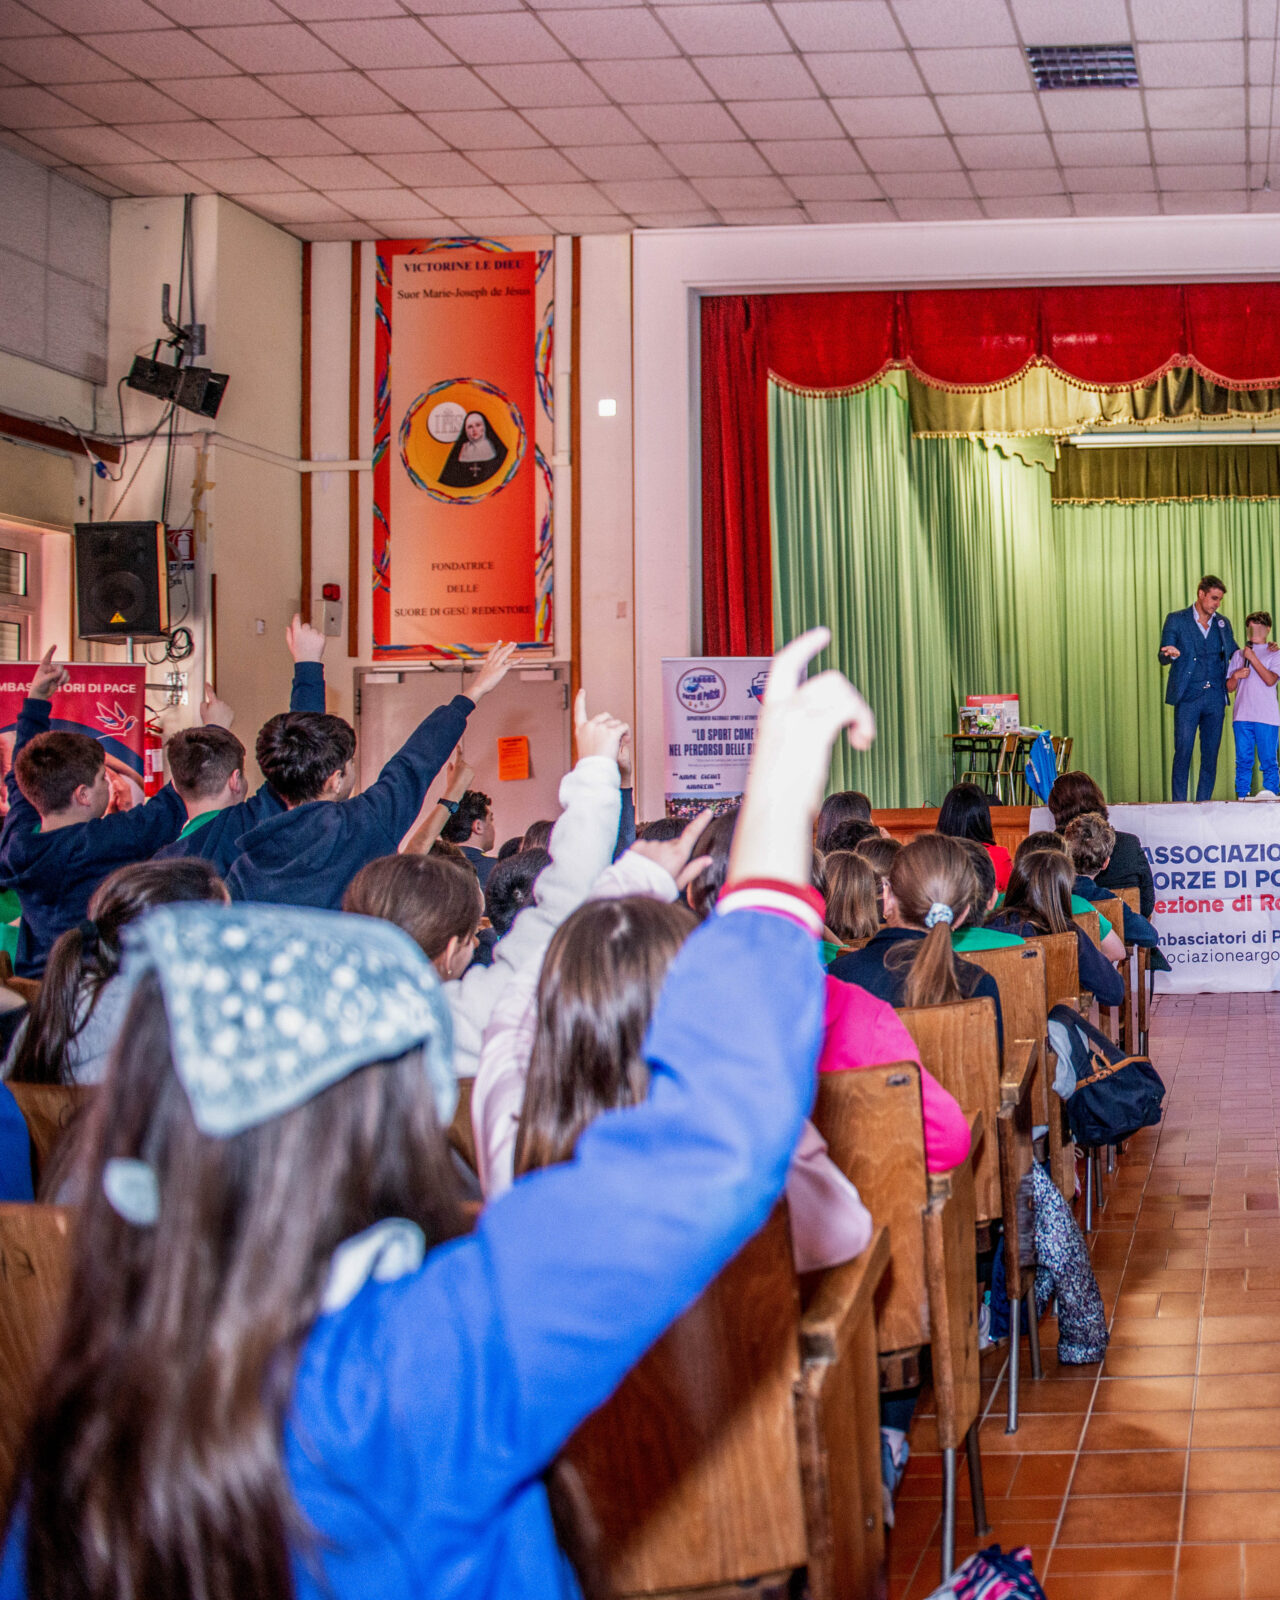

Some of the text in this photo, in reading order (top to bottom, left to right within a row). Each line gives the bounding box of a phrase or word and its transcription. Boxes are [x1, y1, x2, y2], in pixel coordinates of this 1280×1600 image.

[404, 260, 523, 272] VICTORINE LE DIEU
[397, 290, 419, 299] Suor
[423, 287, 488, 299] Marie-Joseph
[491, 287, 502, 296] de
[431, 562, 494, 571] FONDATRICE
[447, 585, 479, 593] DELLE
[394, 608, 427, 617] SUORE
[430, 607, 441, 616] DI
[472, 605, 531, 615] REDENTORE
[0, 682, 136, 693] MBASTORI DI PACE
[708, 729, 731, 740] SPORT
[734, 728, 754, 740] COME
[669, 744, 681, 756] NEL
[684, 744, 723, 756] PERCORSO
[726, 743, 745, 755] DELLE
[1153, 871, 1216, 890] ORZE
[1224, 870, 1247, 888] DI
[1154, 896, 1224, 914] ezione
[1231, 894, 1252, 912] di
[1158, 930, 1246, 946] mbasciatori
[1251, 929, 1267, 944] di
